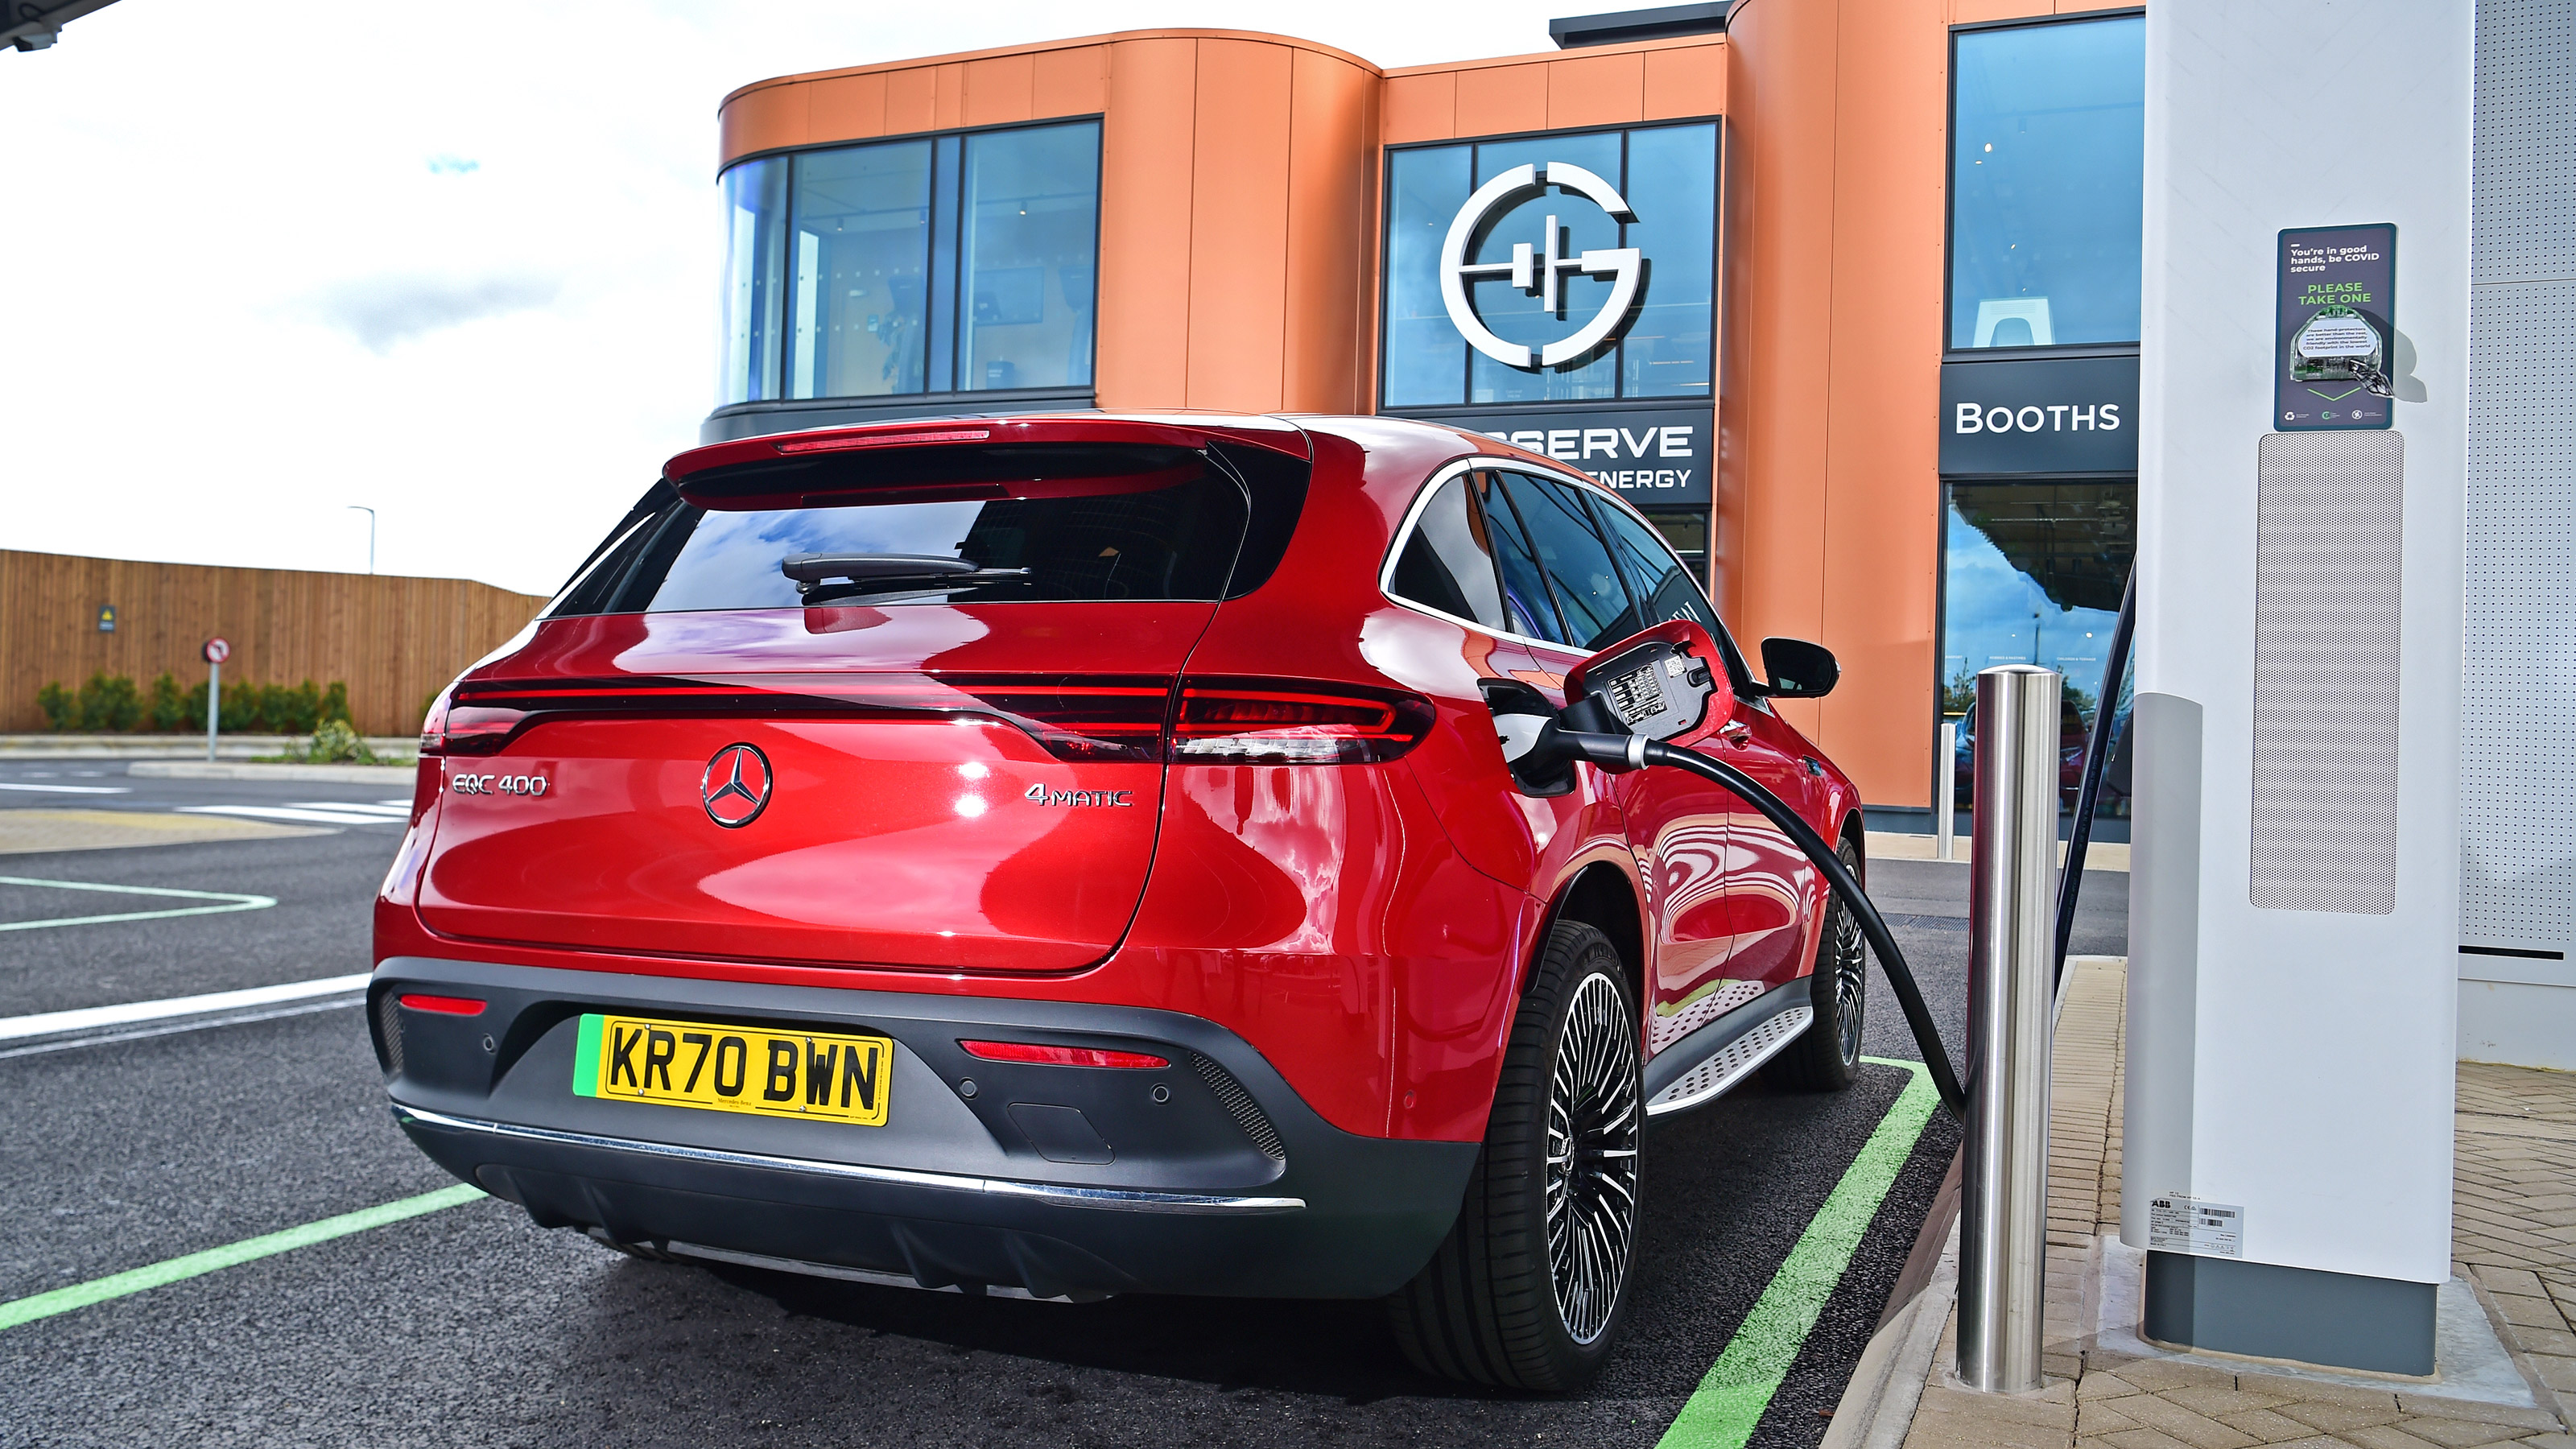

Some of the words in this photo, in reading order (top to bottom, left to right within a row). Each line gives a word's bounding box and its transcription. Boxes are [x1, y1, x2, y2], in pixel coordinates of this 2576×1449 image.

[2290, 247, 2324, 257] You're
[2327, 246, 2337, 255] in
[2339, 245, 2367, 255] good
[2290, 255, 2326, 265] hands,
[2328, 255, 2342, 263] be
[2344, 253, 2380, 262] COVID
[2290, 264, 2326, 273] secure
[2308, 282, 2363, 294] PLEASE
[2298, 294, 2335, 306] TAKE
[2340, 293, 2371, 303] ONE
[1483, 426, 1694, 460] SERVE
[452, 773, 496, 795] EQC
[498, 775, 547, 796] 400
[1024, 783, 1133, 806] 4MATIC
[610, 1027, 748, 1097] KR70
[763, 1038, 879, 1110] BWN
[2152, 1200, 2171, 1209] ABB
